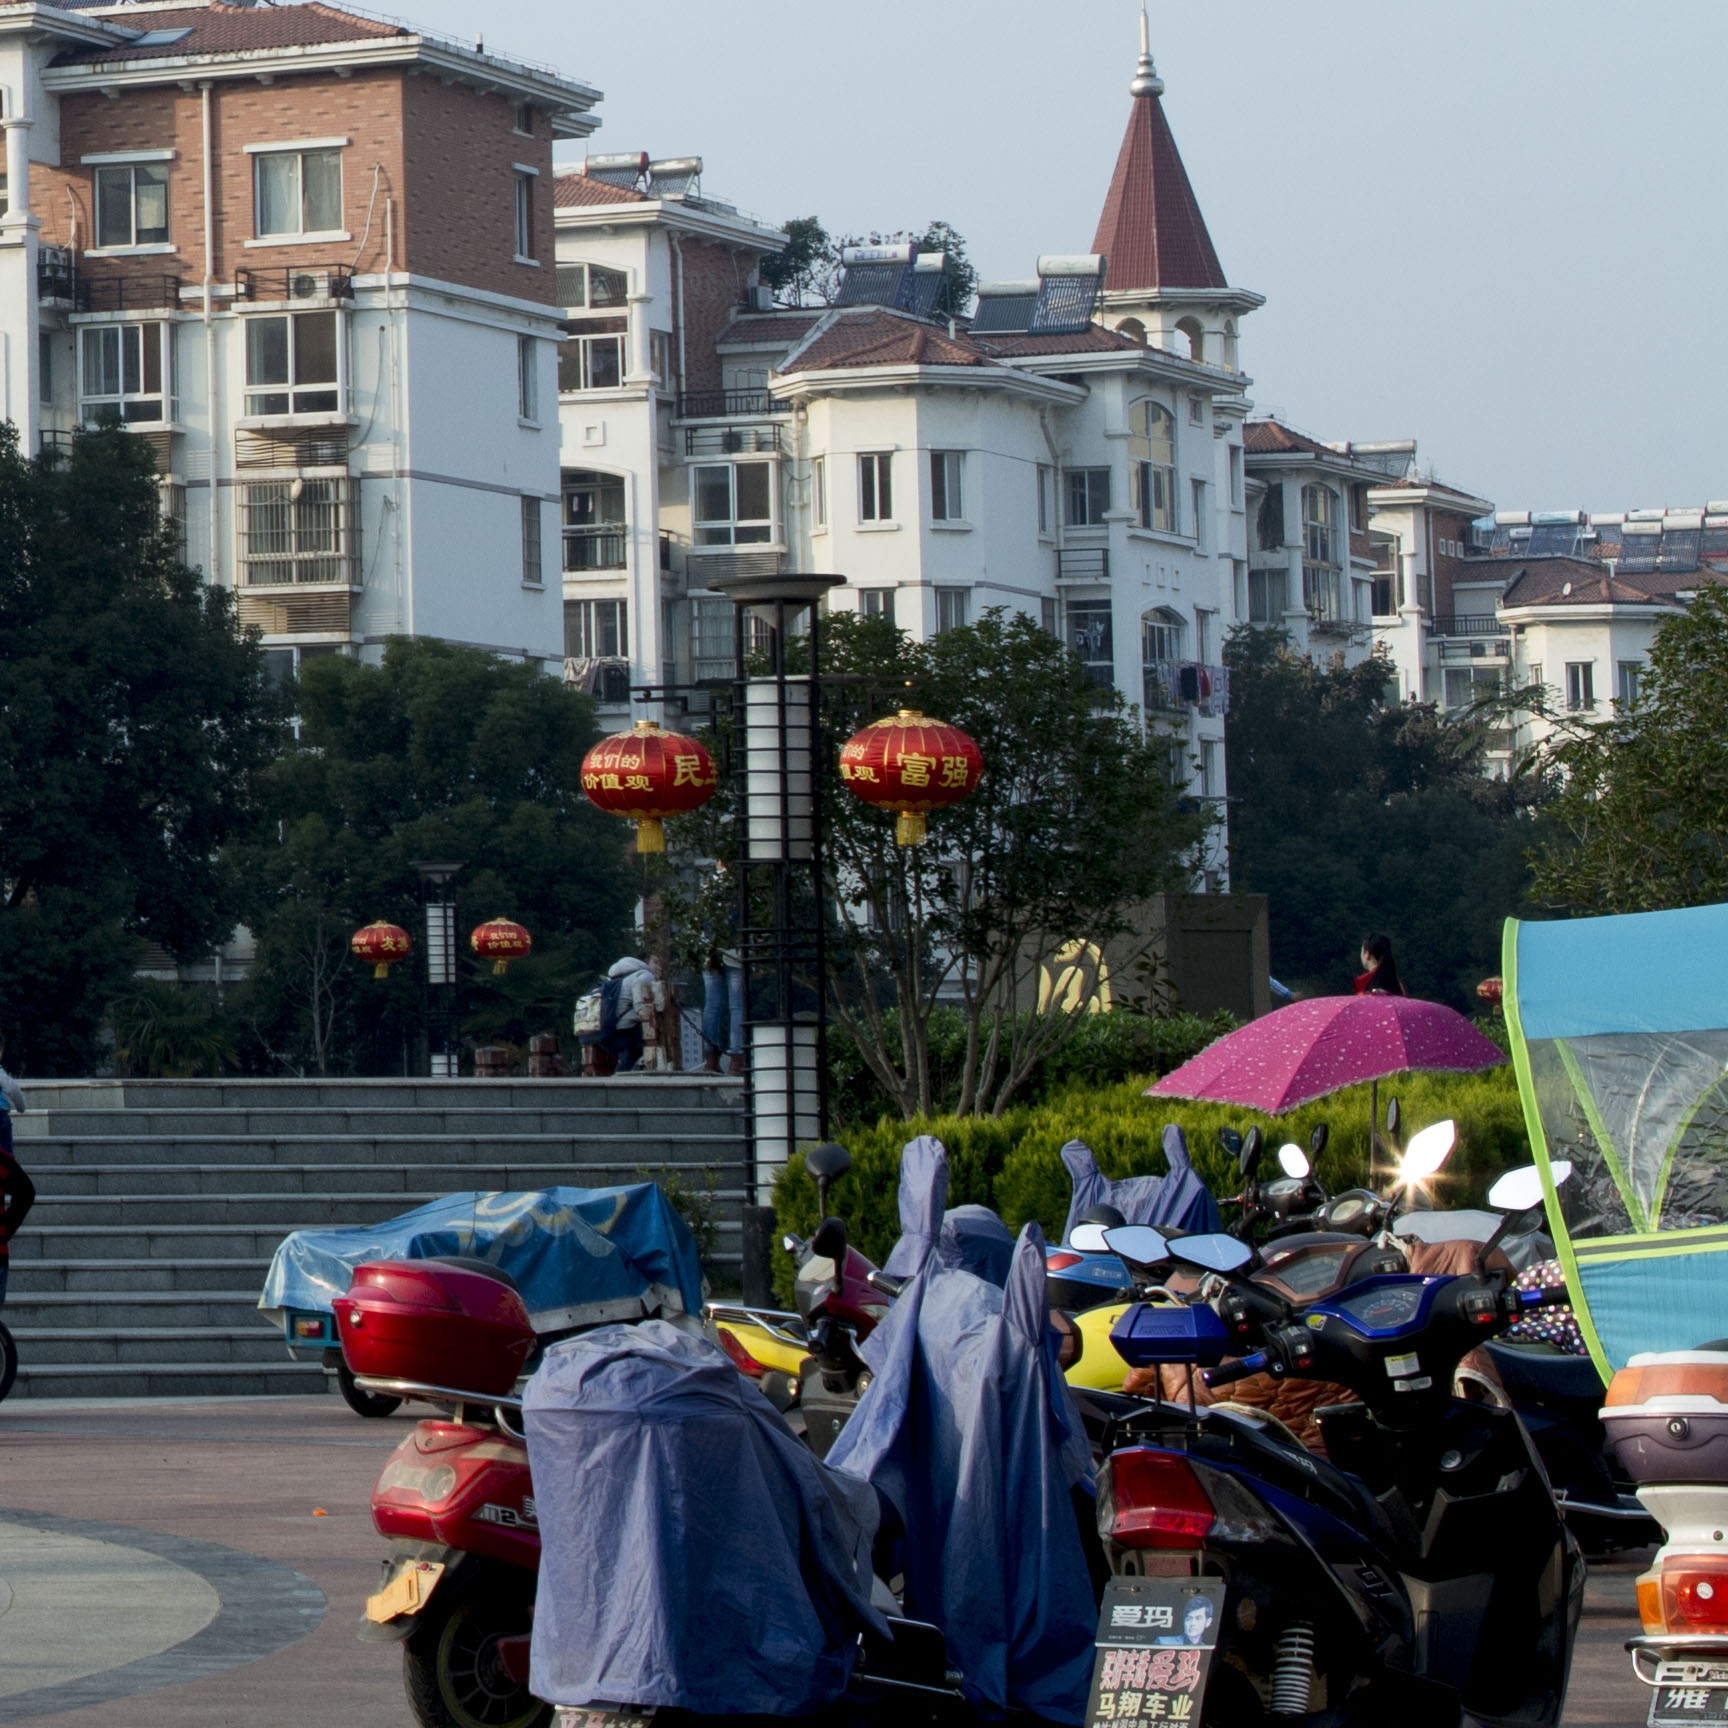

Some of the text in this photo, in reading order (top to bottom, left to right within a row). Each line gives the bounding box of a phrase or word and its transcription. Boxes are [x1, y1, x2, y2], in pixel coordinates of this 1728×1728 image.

[590, 754, 641, 771] 我们的
[897, 752, 968, 788] 富强
[584, 773, 654, 792] 价值观
[1111, 1605, 1174, 1629] 爱玛
[1096, 1691, 1194, 1721] 马翔车业
